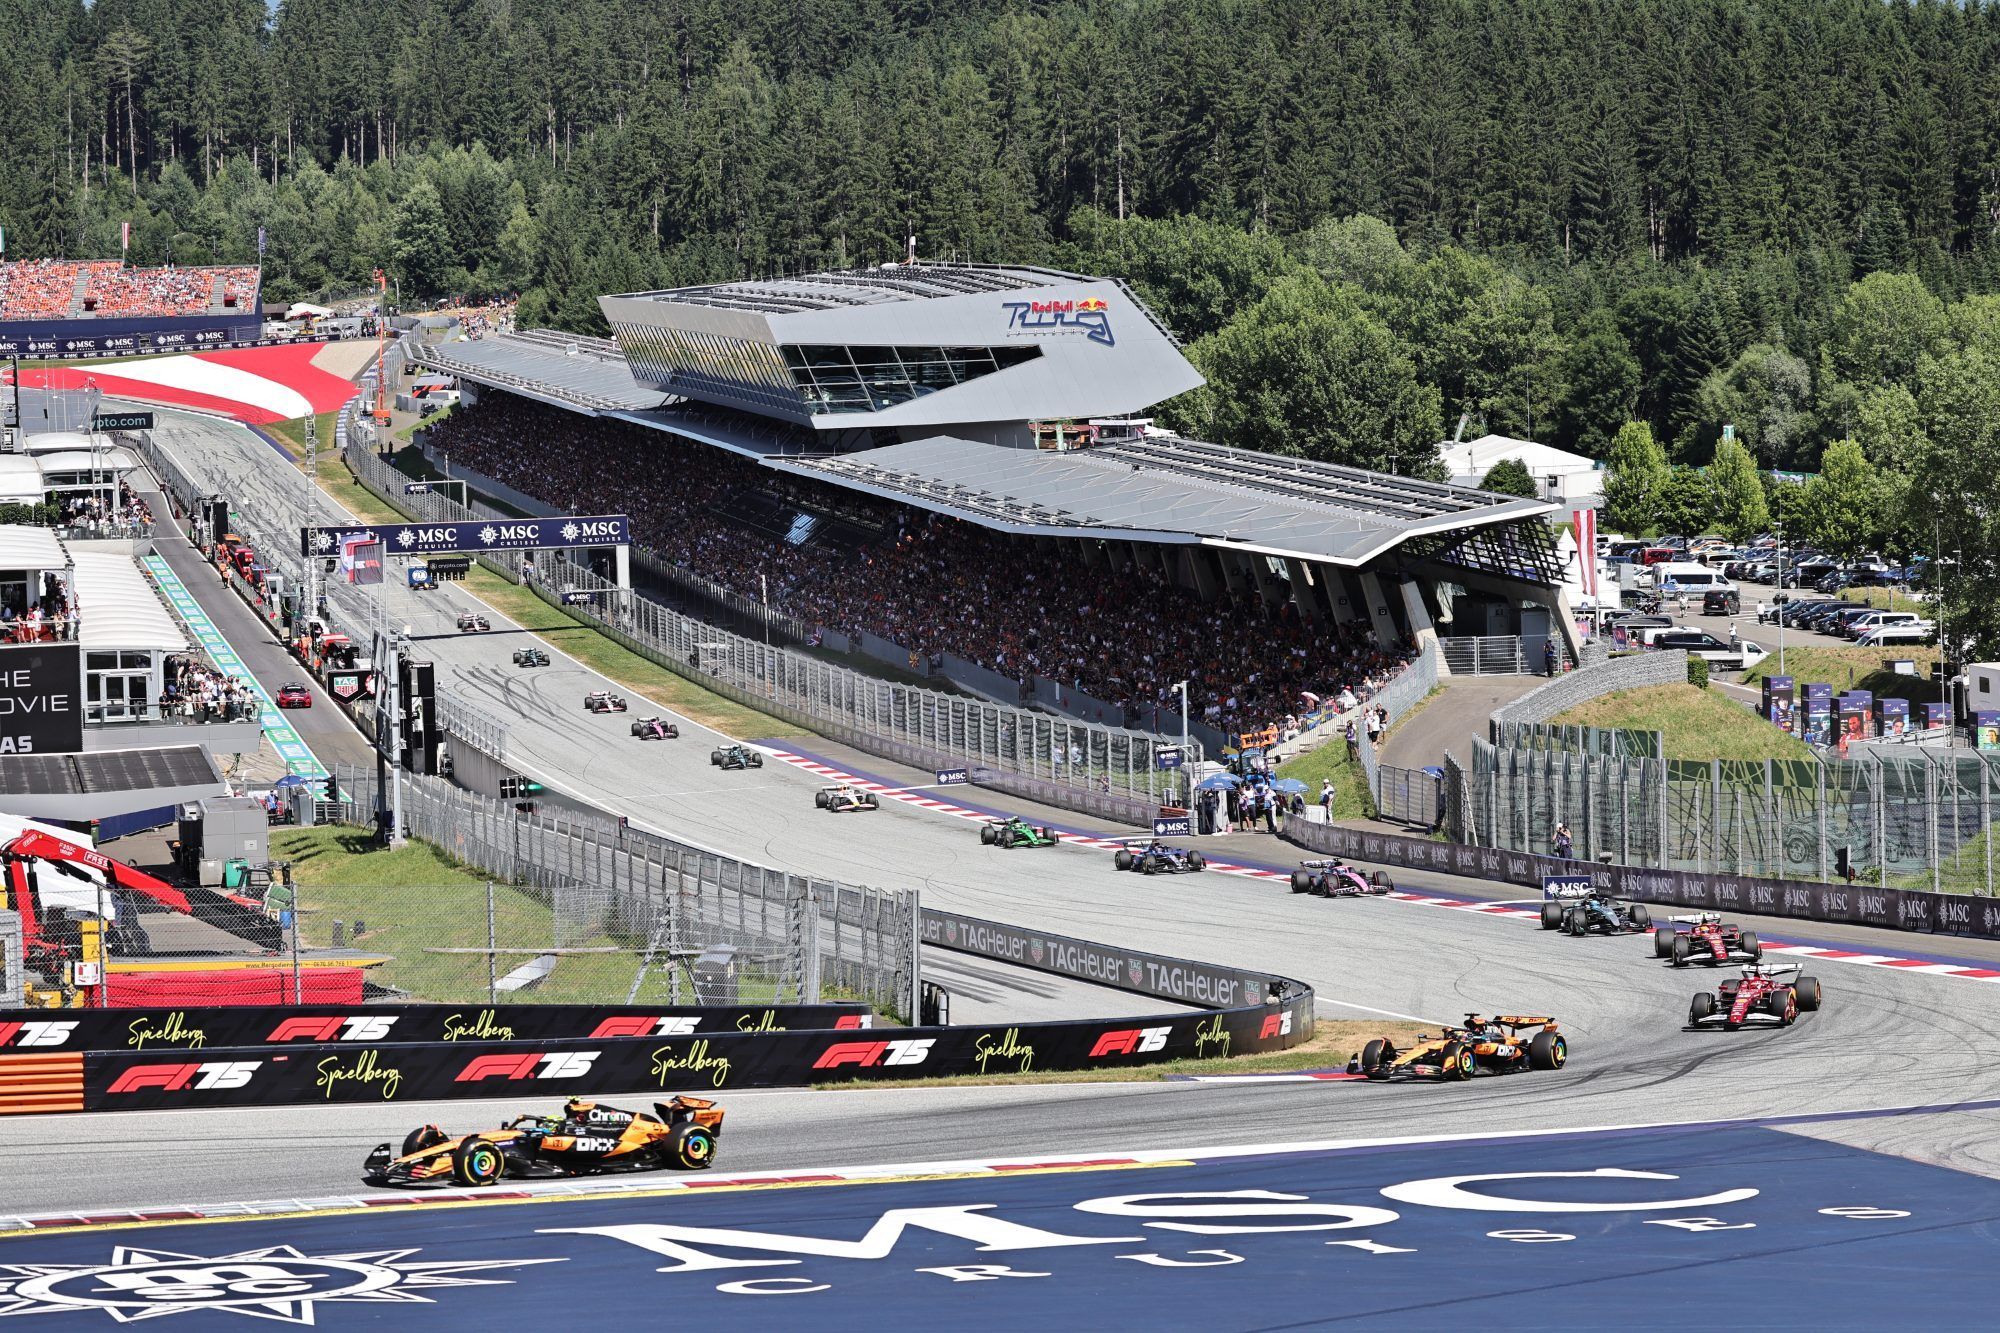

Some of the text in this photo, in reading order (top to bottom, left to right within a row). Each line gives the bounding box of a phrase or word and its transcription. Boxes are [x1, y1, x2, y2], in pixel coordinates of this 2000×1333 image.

[1031, 300, 1073, 314] Red Bull
[38, 342, 56, 350] MSC
[76, 340, 95, 348] MSC
[115, 338, 133, 346] MSC
[167, 334, 185, 342] MSC
[92, 416, 146, 430] ypto.com
[418, 528, 457, 543] MSC
[500, 525, 539, 540] MSC
[582, 521, 620, 536] MSC
[338, 677, 356, 685] TAG
[948, 772, 966, 780] MSC
[1167, 822, 1188, 831] MSC
[86, 853, 108, 868] FASS
[1513, 859, 1527, 875] MSC
[1561, 882, 1588, 893] MSC
[1597, 872, 1611, 887] MSC
[1627, 875, 1642, 890] MSC
[1658, 878, 1673, 894] MSC
[1689, 881, 1706, 897] MSC
[1722, 883, 1739, 900] MSC
[1757, 886, 1774, 903] MSC
[1792, 889, 1810, 907] MSC
[1830, 893, 1848, 911] MSC
[1867, 895, 1886, 914] MSC
[1907, 900, 1927, 919] MSC
[1949, 903, 1970, 922] MSC
[918, 917, 942, 941] euer
[17, 1021, 80, 1046] 75
[129, 1012, 207, 1049] Spielberg
[340, 1016, 400, 1041] 75
[443, 1009, 516, 1041] Spielberg
[654, 1016, 702, 1037] 75
[1088, 1026, 1173, 1057] F1 75
[1195, 1014, 1231, 1058] Spielberg
[812, 1039, 937, 1069] F1 75
[975, 1028, 1034, 1073] Spielberg
[454, 1051, 602, 1082] F1 75
[651, 1039, 731, 1087] Spielberg
[106, 1061, 263, 1093] F1 75
[317, 1050, 403, 1098] Spielberg
[589, 1109, 633, 1123] Chrome
[535, 1167, 1760, 1272] MSC
[715, 1205, 1912, 1295] CRUISES
